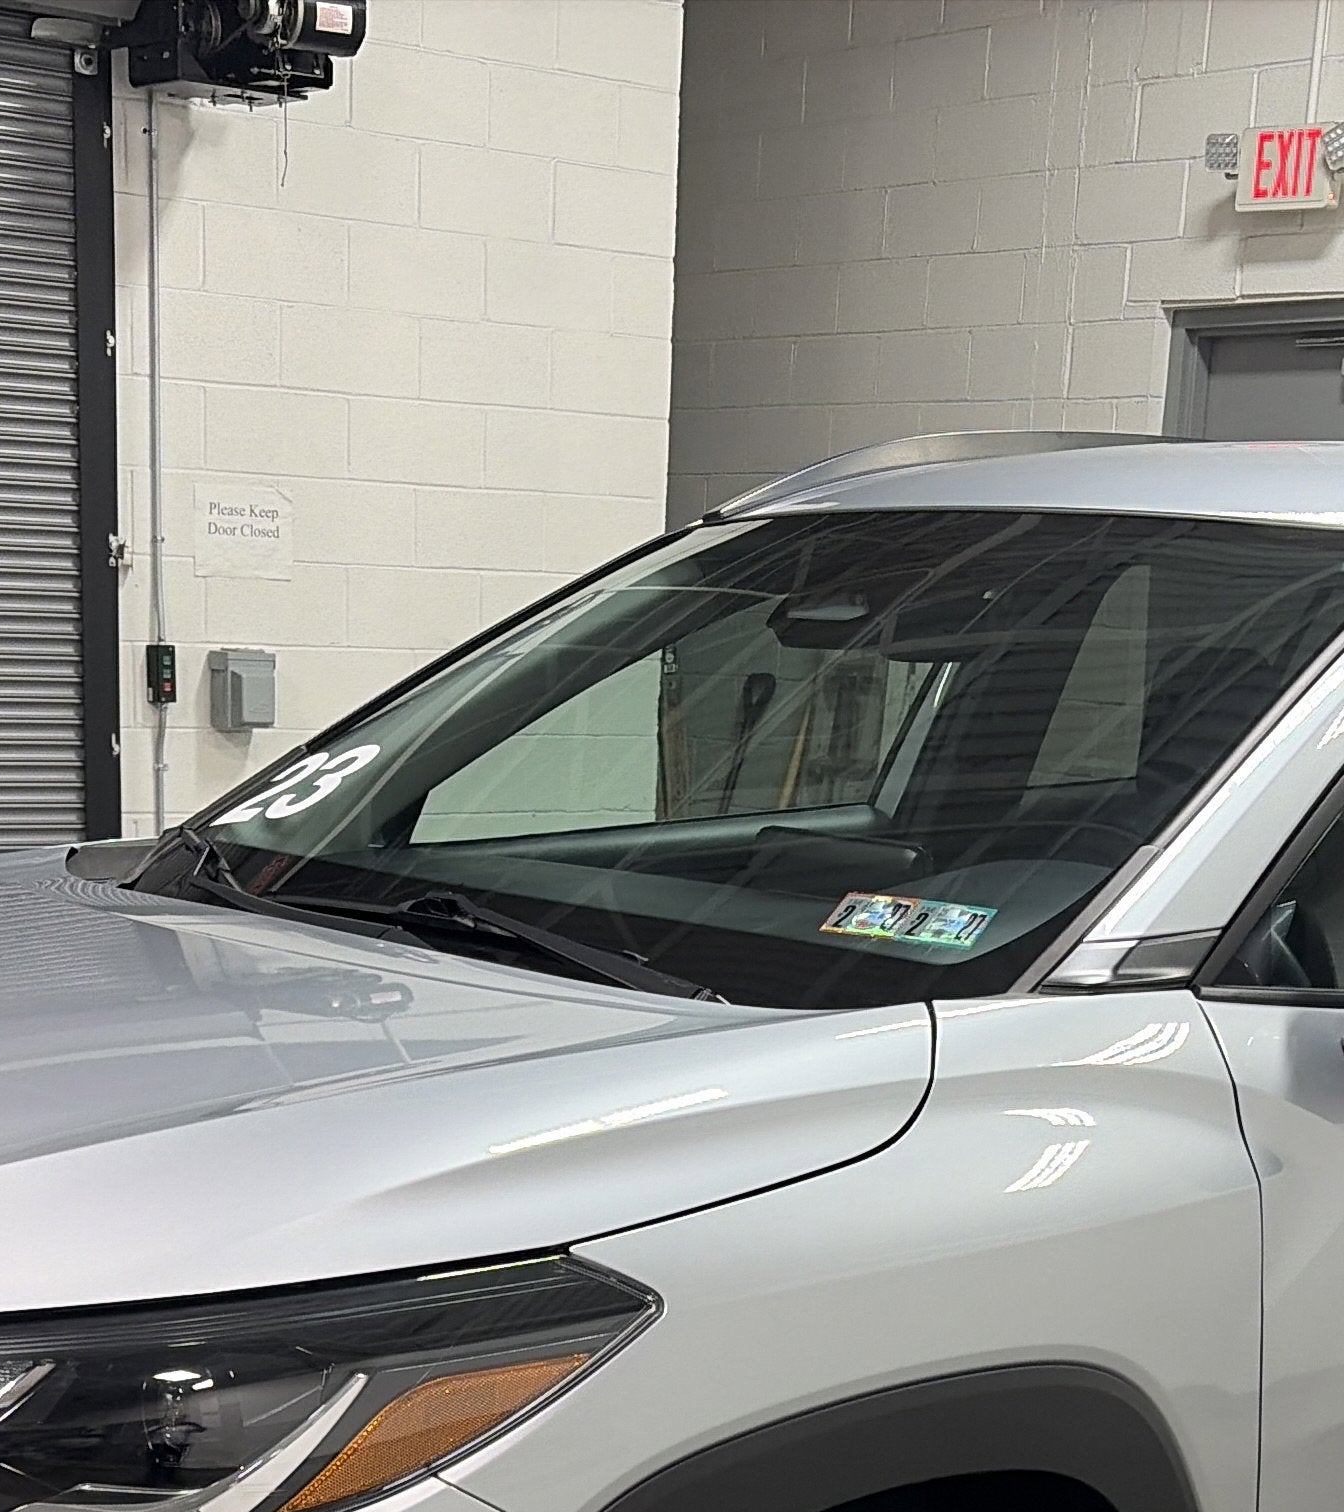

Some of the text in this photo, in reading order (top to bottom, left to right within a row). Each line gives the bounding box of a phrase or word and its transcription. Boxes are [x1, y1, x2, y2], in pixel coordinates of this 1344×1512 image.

[1253, 129, 1322, 198] EXIT
[209, 502, 279, 522] Please Keep
[208, 521, 280, 538] Door Closed
[209, 744, 380, 827] 23
[832, 905, 857, 928] 2
[904, 912, 988, 941] 2 27
